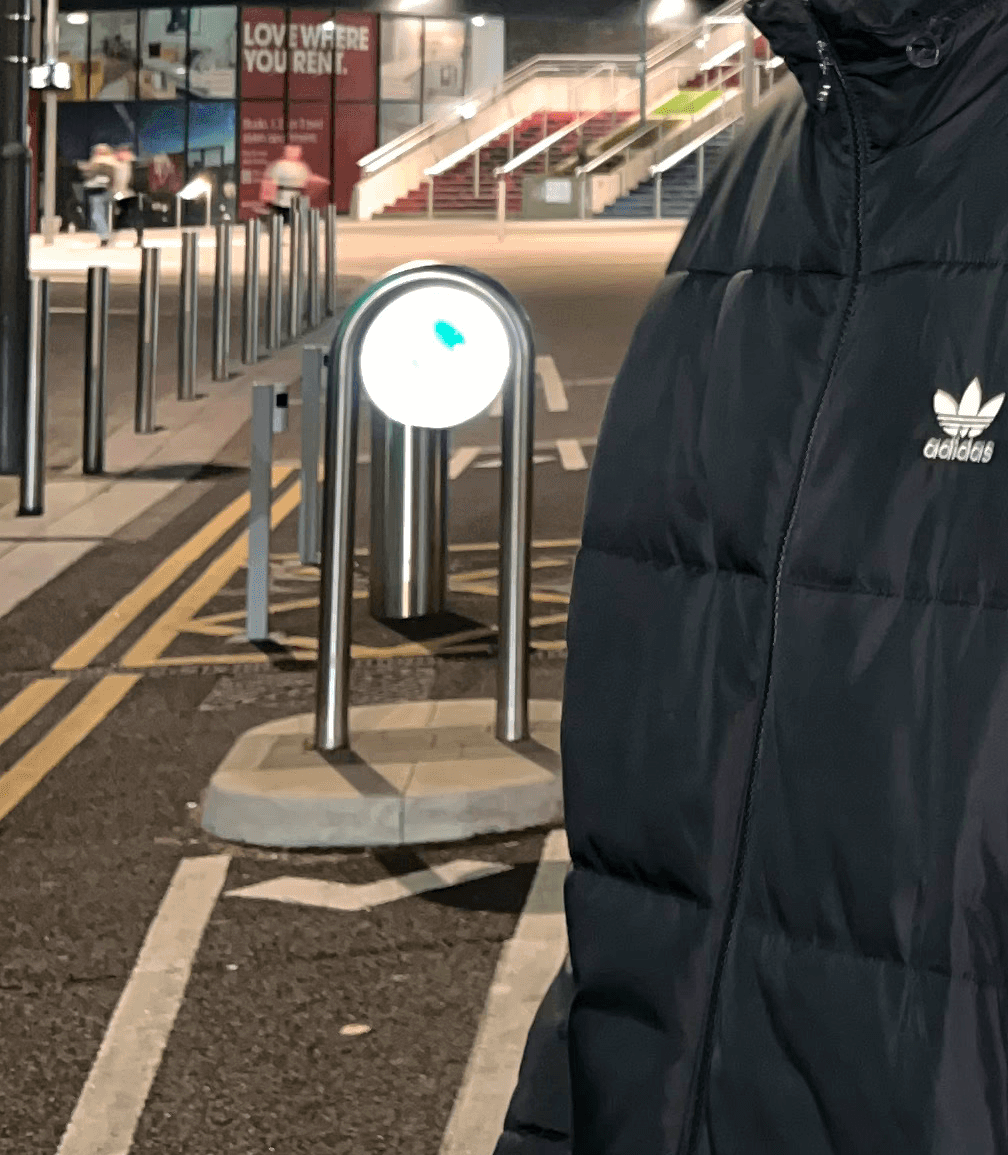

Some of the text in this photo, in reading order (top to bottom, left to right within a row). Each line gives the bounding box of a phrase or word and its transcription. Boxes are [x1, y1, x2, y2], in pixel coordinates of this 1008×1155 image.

[243, 22, 369, 51] LOVE WHERE
[243, 48, 348, 75] YOU RENT.
[923, 436, 995, 464] adidas
